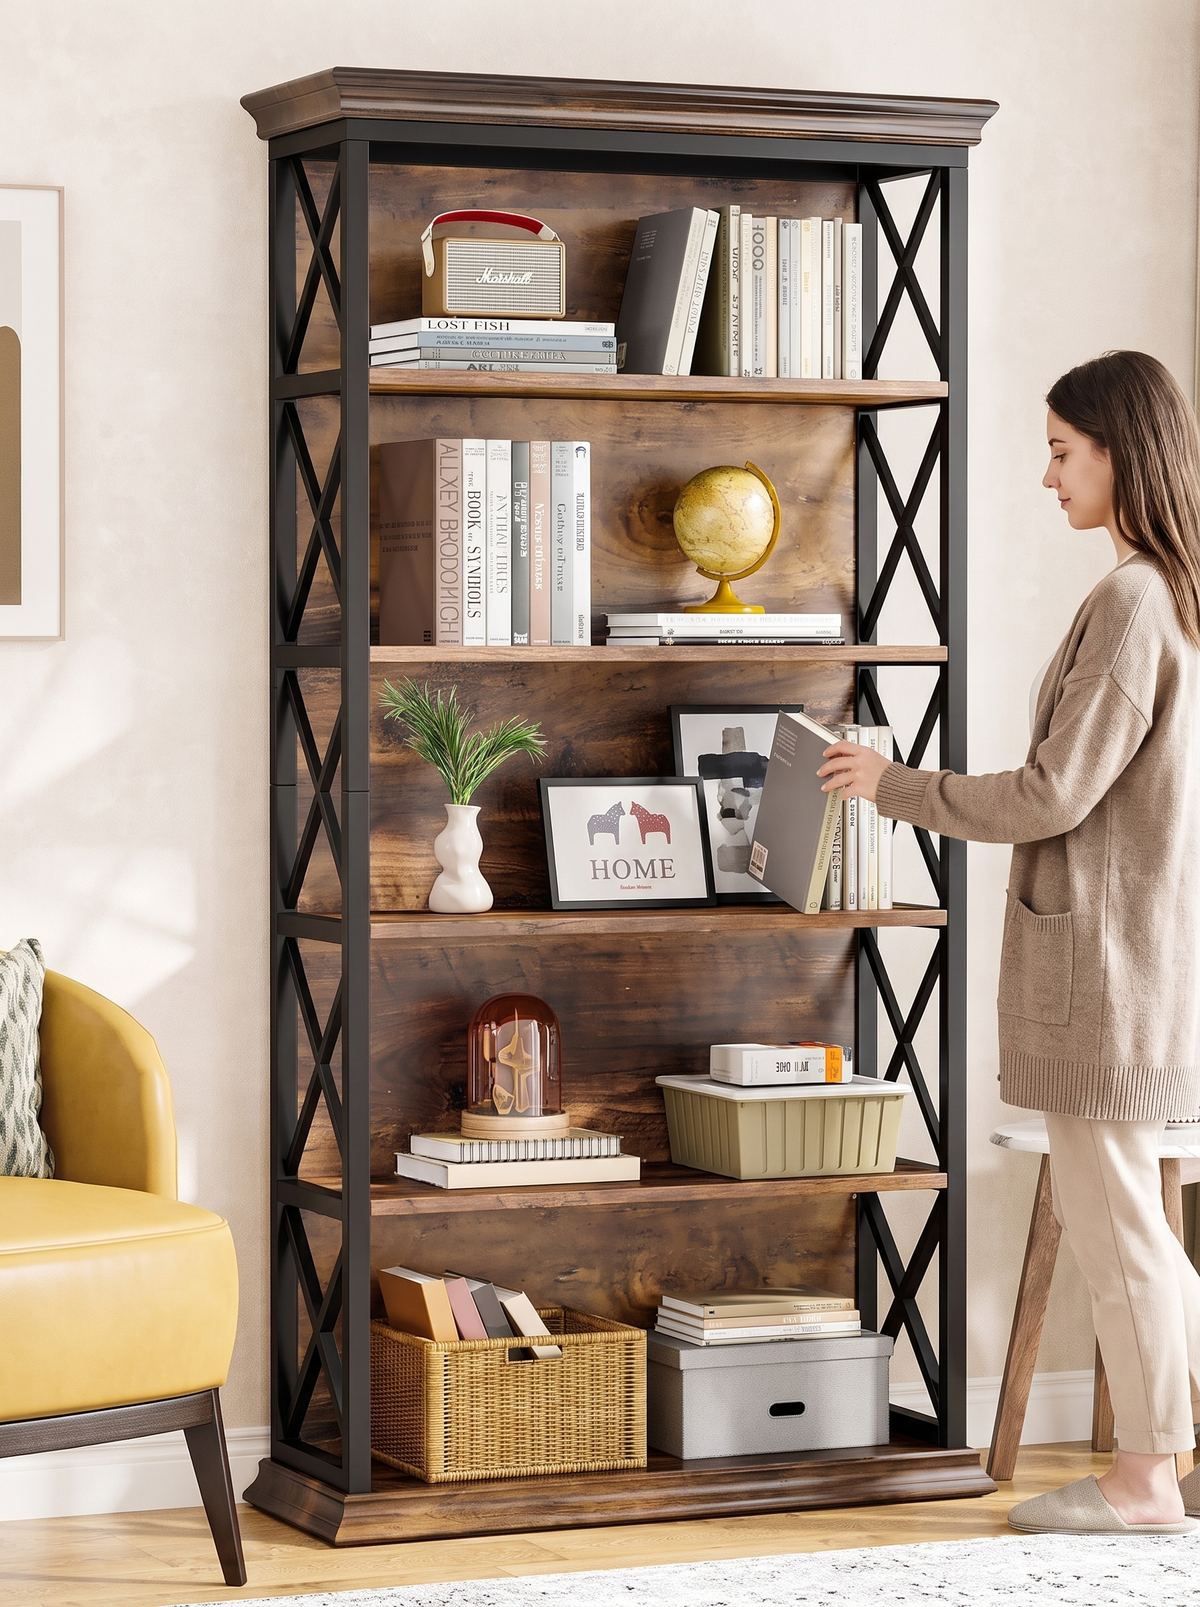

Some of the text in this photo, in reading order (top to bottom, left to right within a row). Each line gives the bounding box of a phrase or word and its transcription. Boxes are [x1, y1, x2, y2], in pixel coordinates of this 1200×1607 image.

[475, 267, 534, 285] Marshall
[427, 319, 511, 331] LOST FISH
[467, 490, 482, 530] BOOK
[590, 858, 676, 880] HOME
